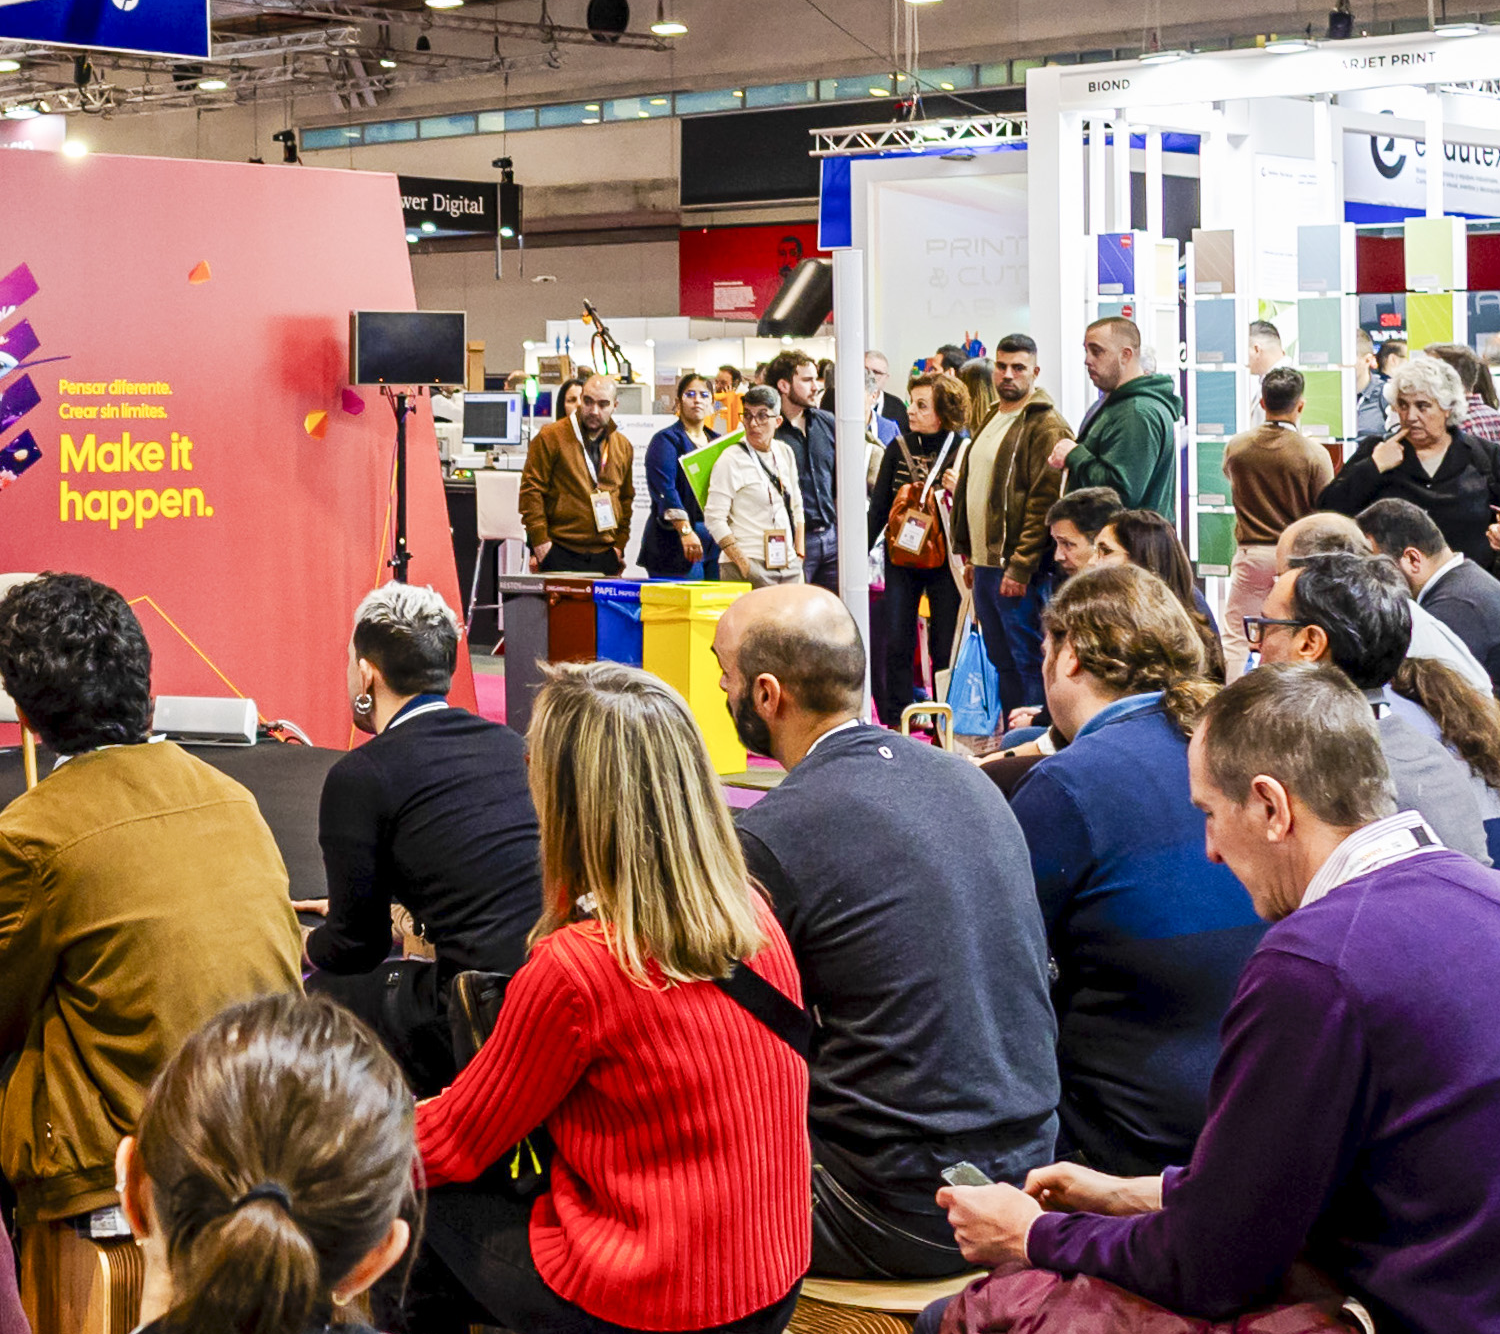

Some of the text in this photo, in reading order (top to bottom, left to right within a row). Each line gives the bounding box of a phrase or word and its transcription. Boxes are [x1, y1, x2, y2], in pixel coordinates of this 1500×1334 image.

[1391, 52, 1436, 67] PRINT
[432, 193, 485, 218] Digital
[926, 235, 1029, 259] PRINT
[928, 265, 1029, 290] & CUT
[926, 298, 997, 319] LAB
[1381, 313, 1402, 327] 3M
[59, 378, 174, 395] Pensar diferente.
[59, 402, 99, 419] Crear
[100, 402, 119, 419] sin
[60, 431, 194, 473] Make it
[60, 480, 215, 530] happen.
